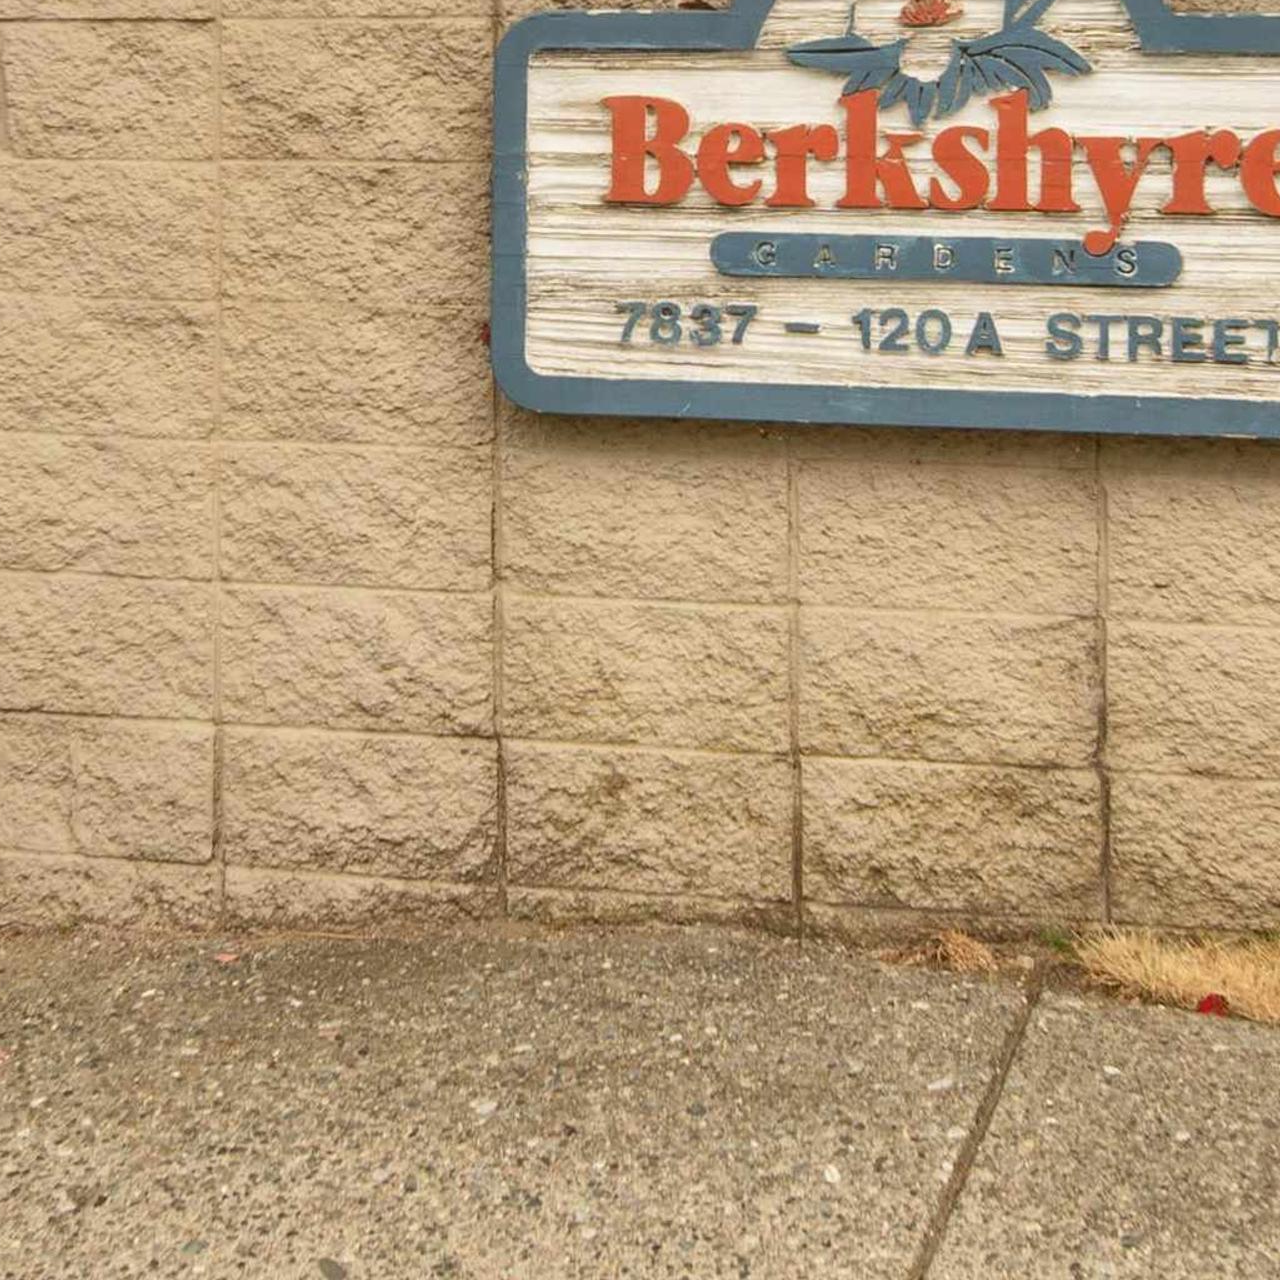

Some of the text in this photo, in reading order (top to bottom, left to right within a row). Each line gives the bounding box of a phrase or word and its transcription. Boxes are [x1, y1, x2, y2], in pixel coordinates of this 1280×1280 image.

[754, 241, 1138, 275] GARDENS
[616, 301, 758, 347] 7837
[1045, 312, 1280, 365] STREET
